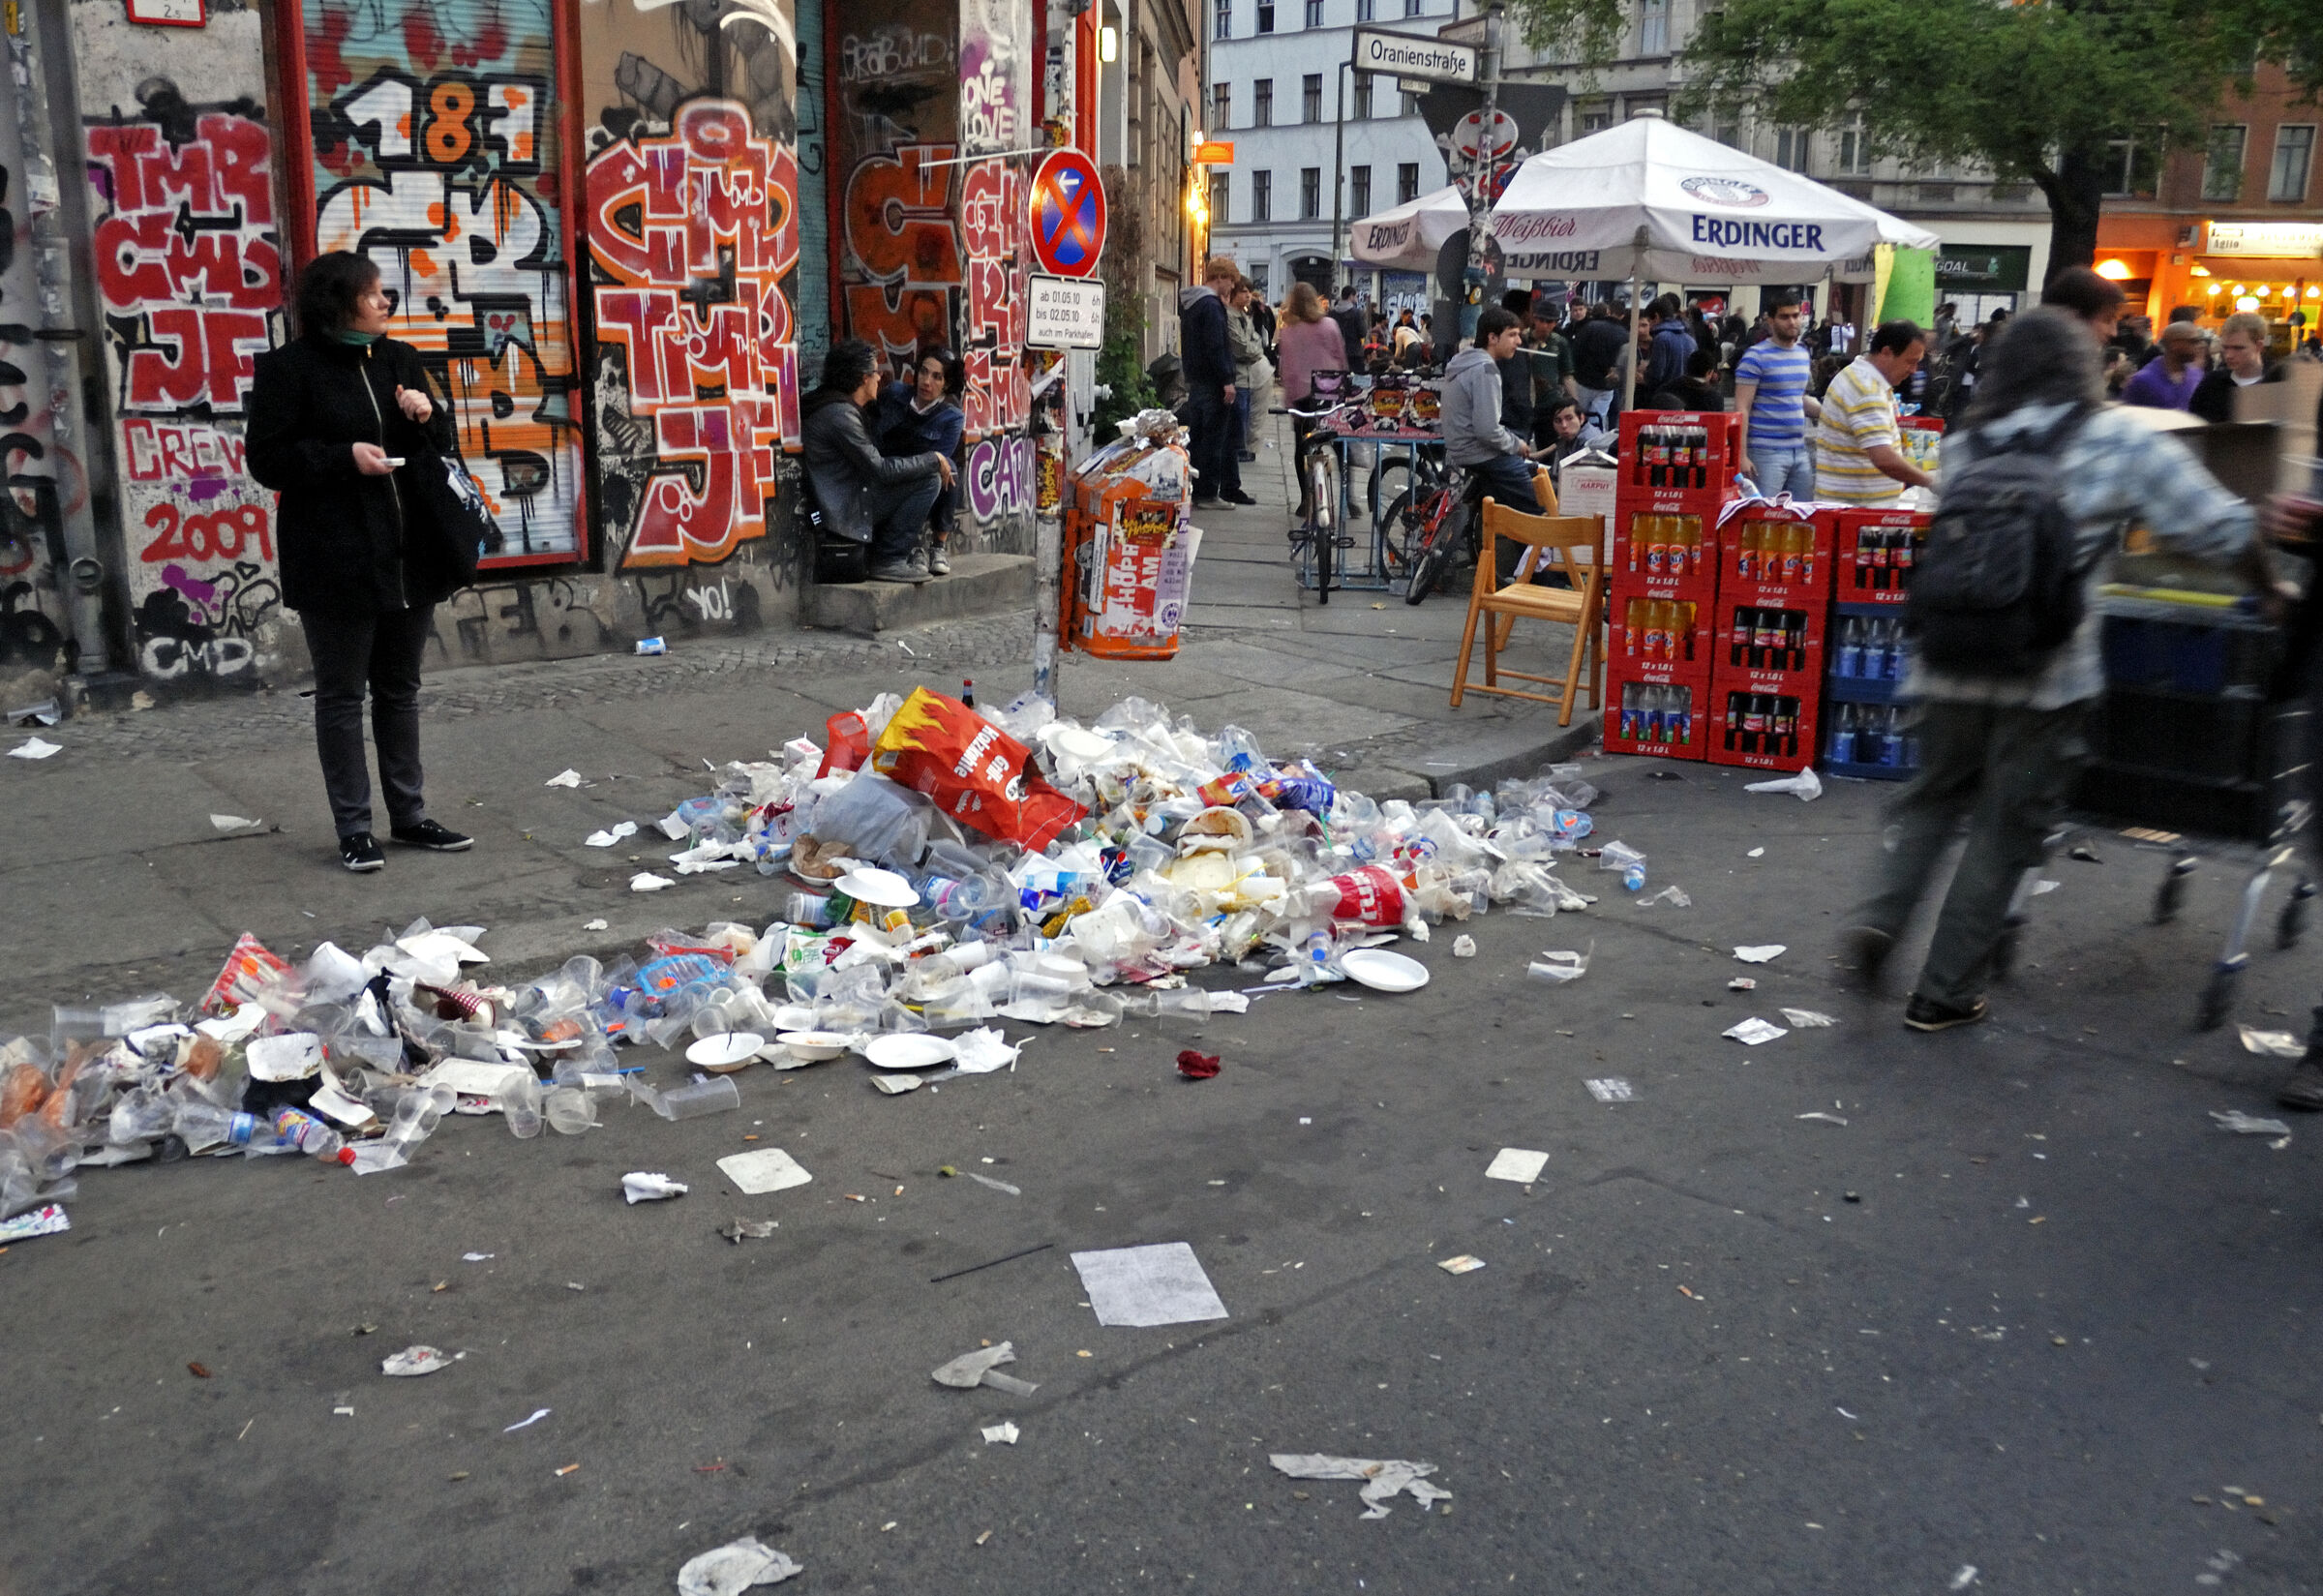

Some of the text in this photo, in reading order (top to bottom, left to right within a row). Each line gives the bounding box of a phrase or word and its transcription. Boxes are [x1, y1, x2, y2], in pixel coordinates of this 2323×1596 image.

[1371, 39, 1465, 75] Oranienstraße
[964, 75, 1007, 109] ONE
[964, 106, 1016, 143] LOVE
[1493, 213, 1577, 245] Weißbier
[1692, 214, 1826, 252] ERDINGER
[1936, 261, 1969, 272] GOAL
[1036, 307, 1046, 319] bis
[1050, 308, 1079, 322] 02.05.10
[1041, 289, 1101, 306] ab 01.05.10 6h
[1039, 328, 1052, 338] auch
[141, 503, 273, 562] 2009
[686, 579, 733, 620] YO!
[142, 637, 253, 678] CMD
